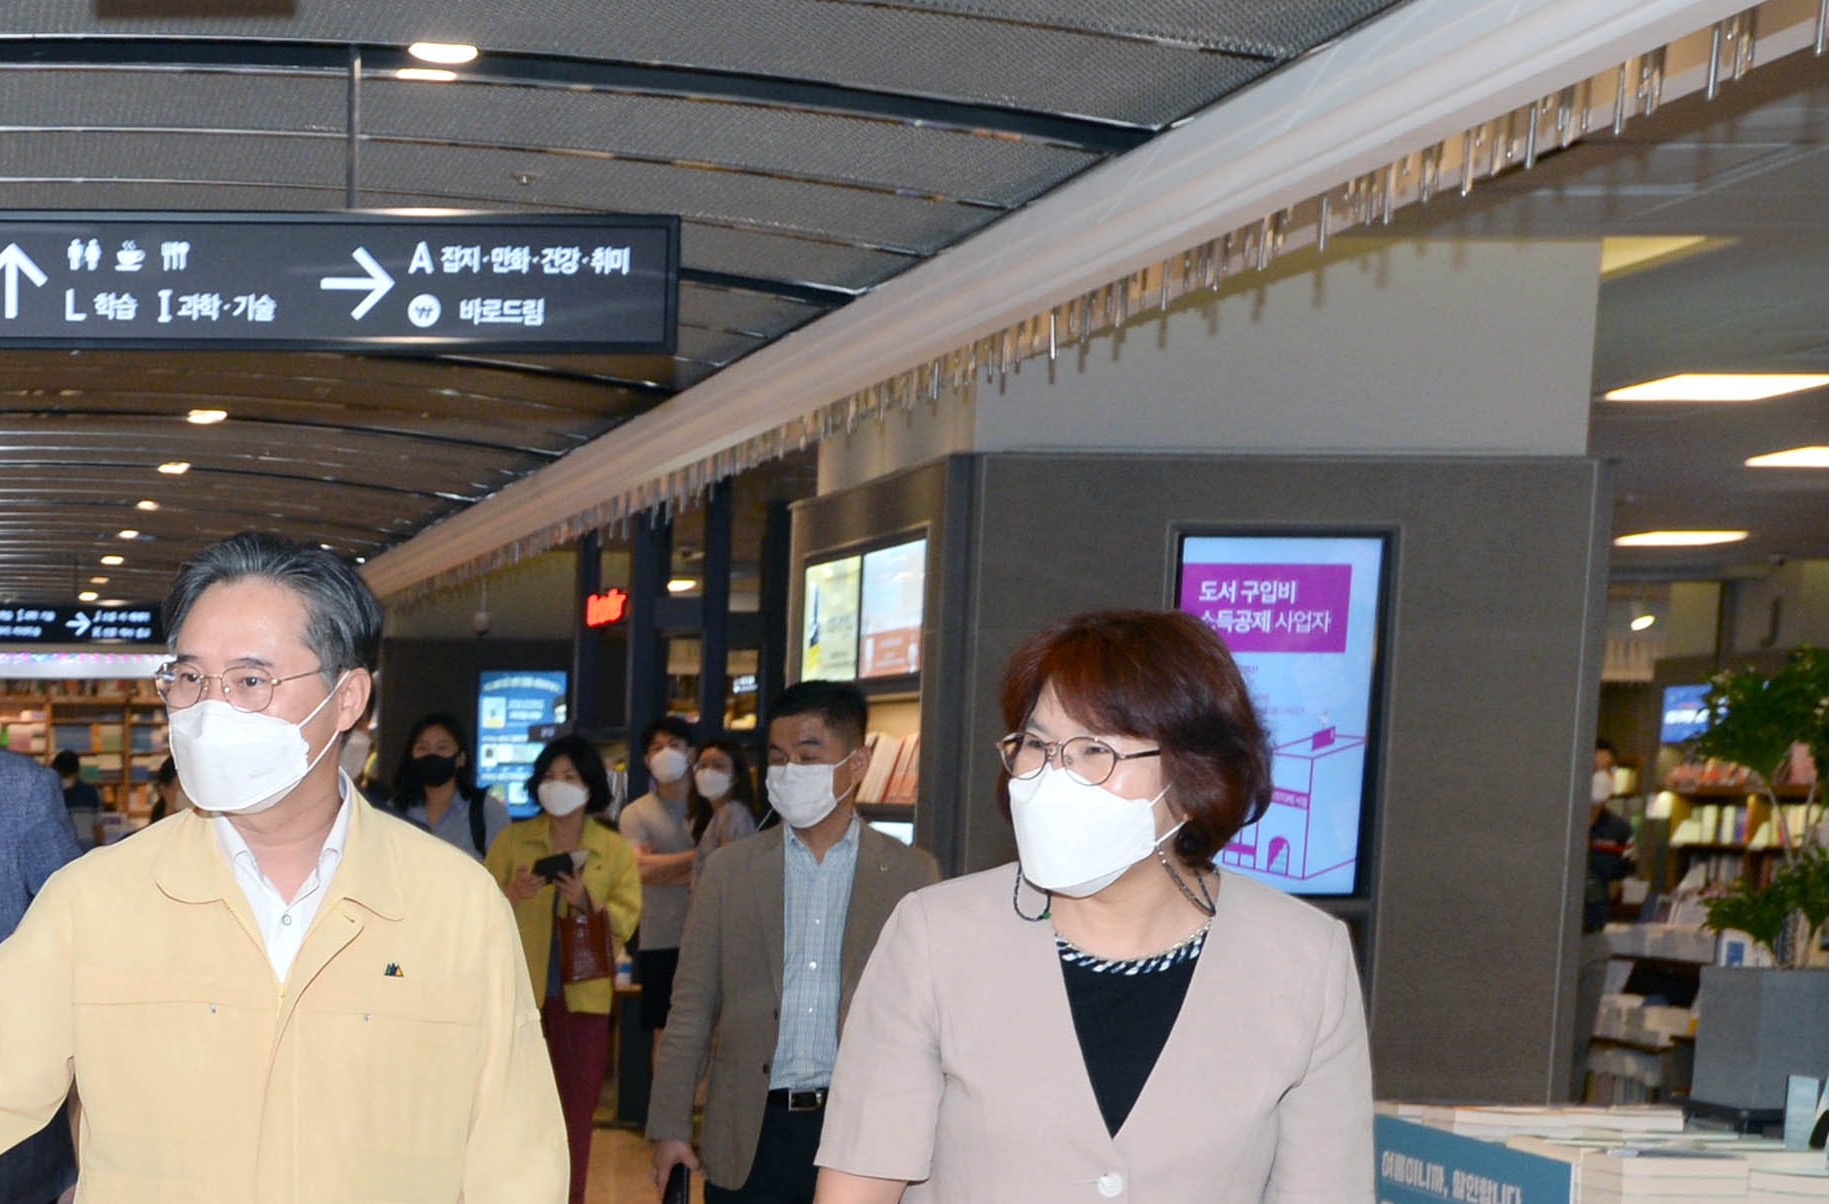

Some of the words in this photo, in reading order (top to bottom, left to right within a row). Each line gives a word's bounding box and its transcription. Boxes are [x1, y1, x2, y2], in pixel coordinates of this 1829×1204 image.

[408, 241, 435, 275] A
[65, 288, 87, 321] L
[93, 292, 138, 321] 학습
[157, 289, 173, 323] I
[459, 297, 546, 327] 바로드림
[1198, 579, 1237, 604] 도서
[1240, 579, 1297, 605] 구입비
[1274, 610, 1332, 634] 사업자
